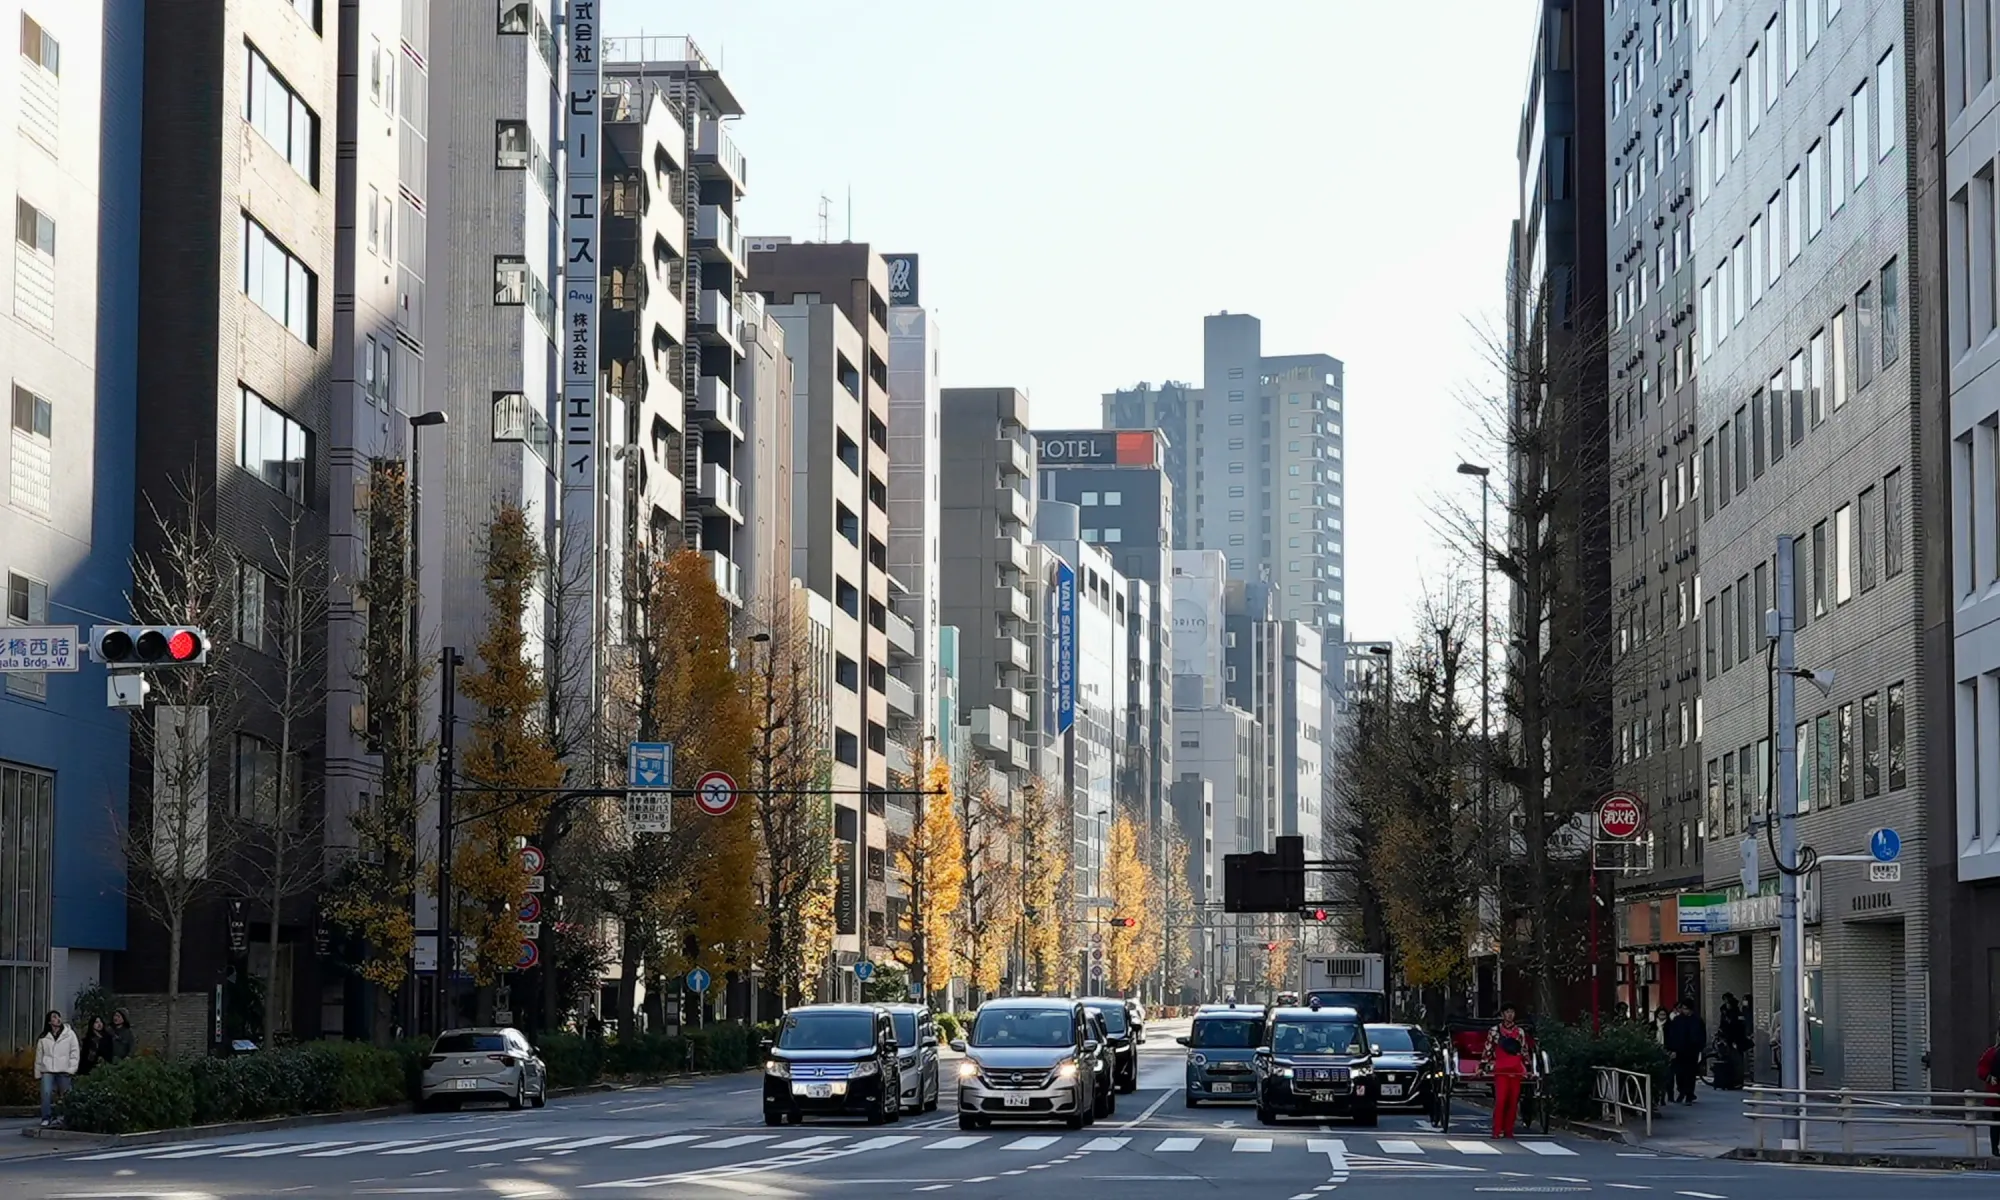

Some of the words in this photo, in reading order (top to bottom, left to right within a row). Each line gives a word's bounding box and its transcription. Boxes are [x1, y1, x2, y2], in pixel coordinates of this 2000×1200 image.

[569, 89, 596, 263] ビーエス
[568, 290, 593, 304] Any
[572, 312, 588, 375] 株式会社
[1061, 580, 1071, 611] VAN
[705, 784, 727, 802] 50
[1604, 810, 1636, 824] 消火栓
